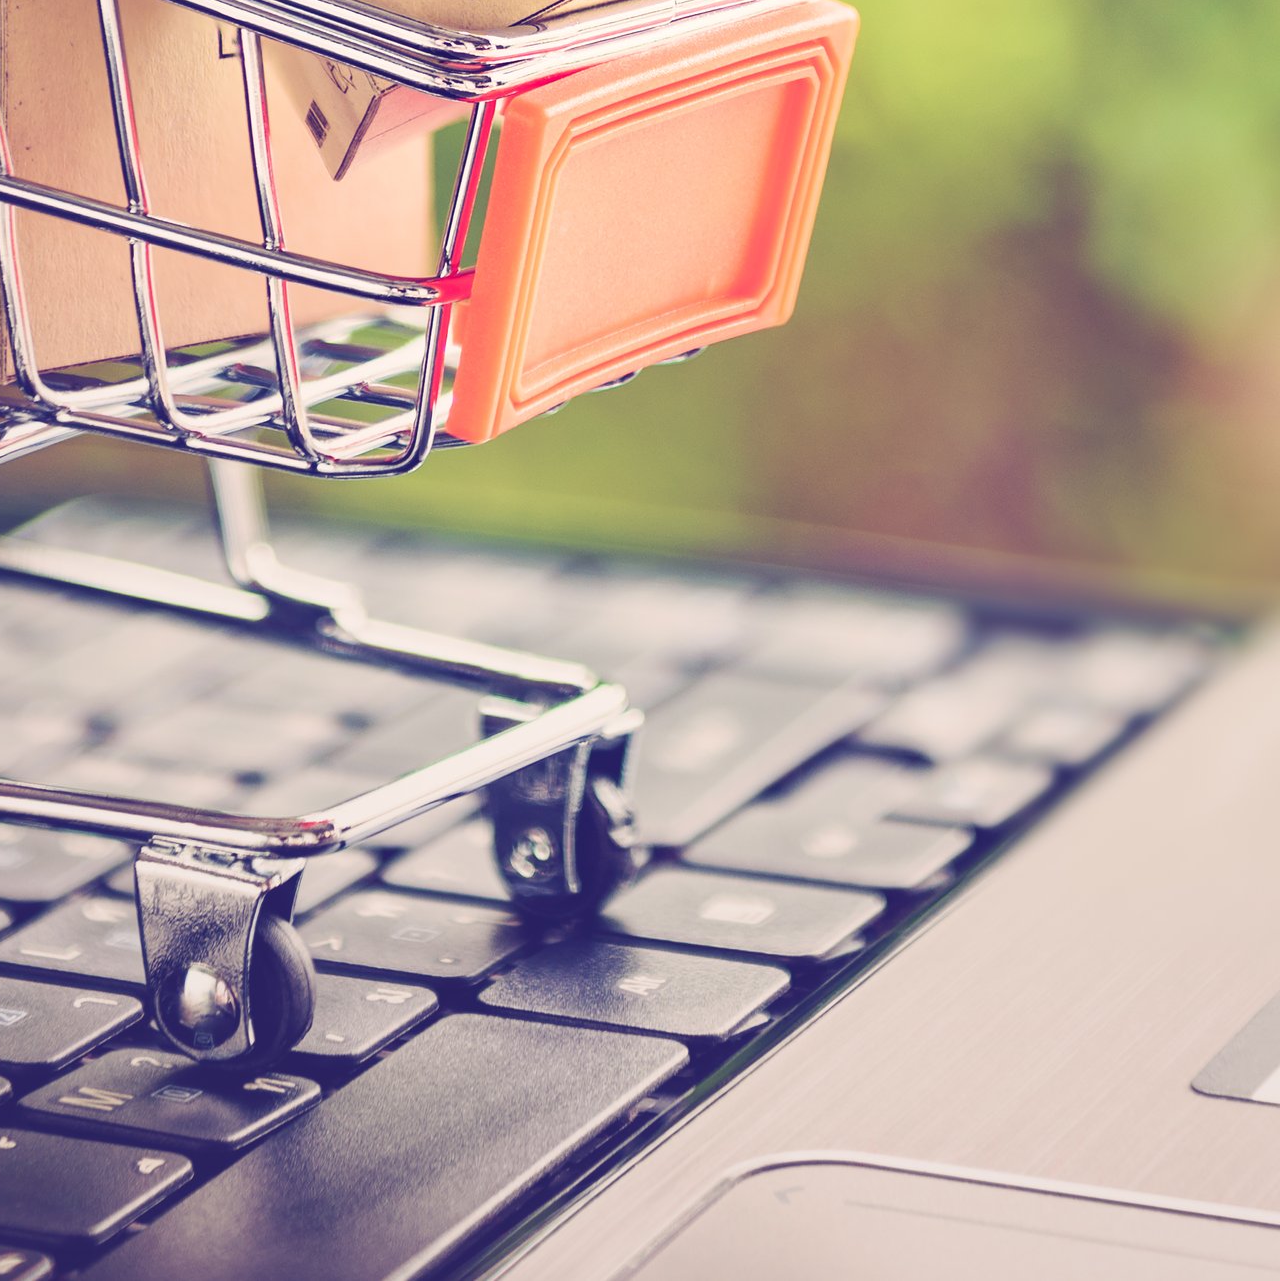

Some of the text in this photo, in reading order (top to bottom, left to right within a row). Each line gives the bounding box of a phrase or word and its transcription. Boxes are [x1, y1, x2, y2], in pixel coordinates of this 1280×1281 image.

[21, 941, 81, 960] L
[619, 975, 667, 996] Alt
[59, 1086, 134, 1111] M
